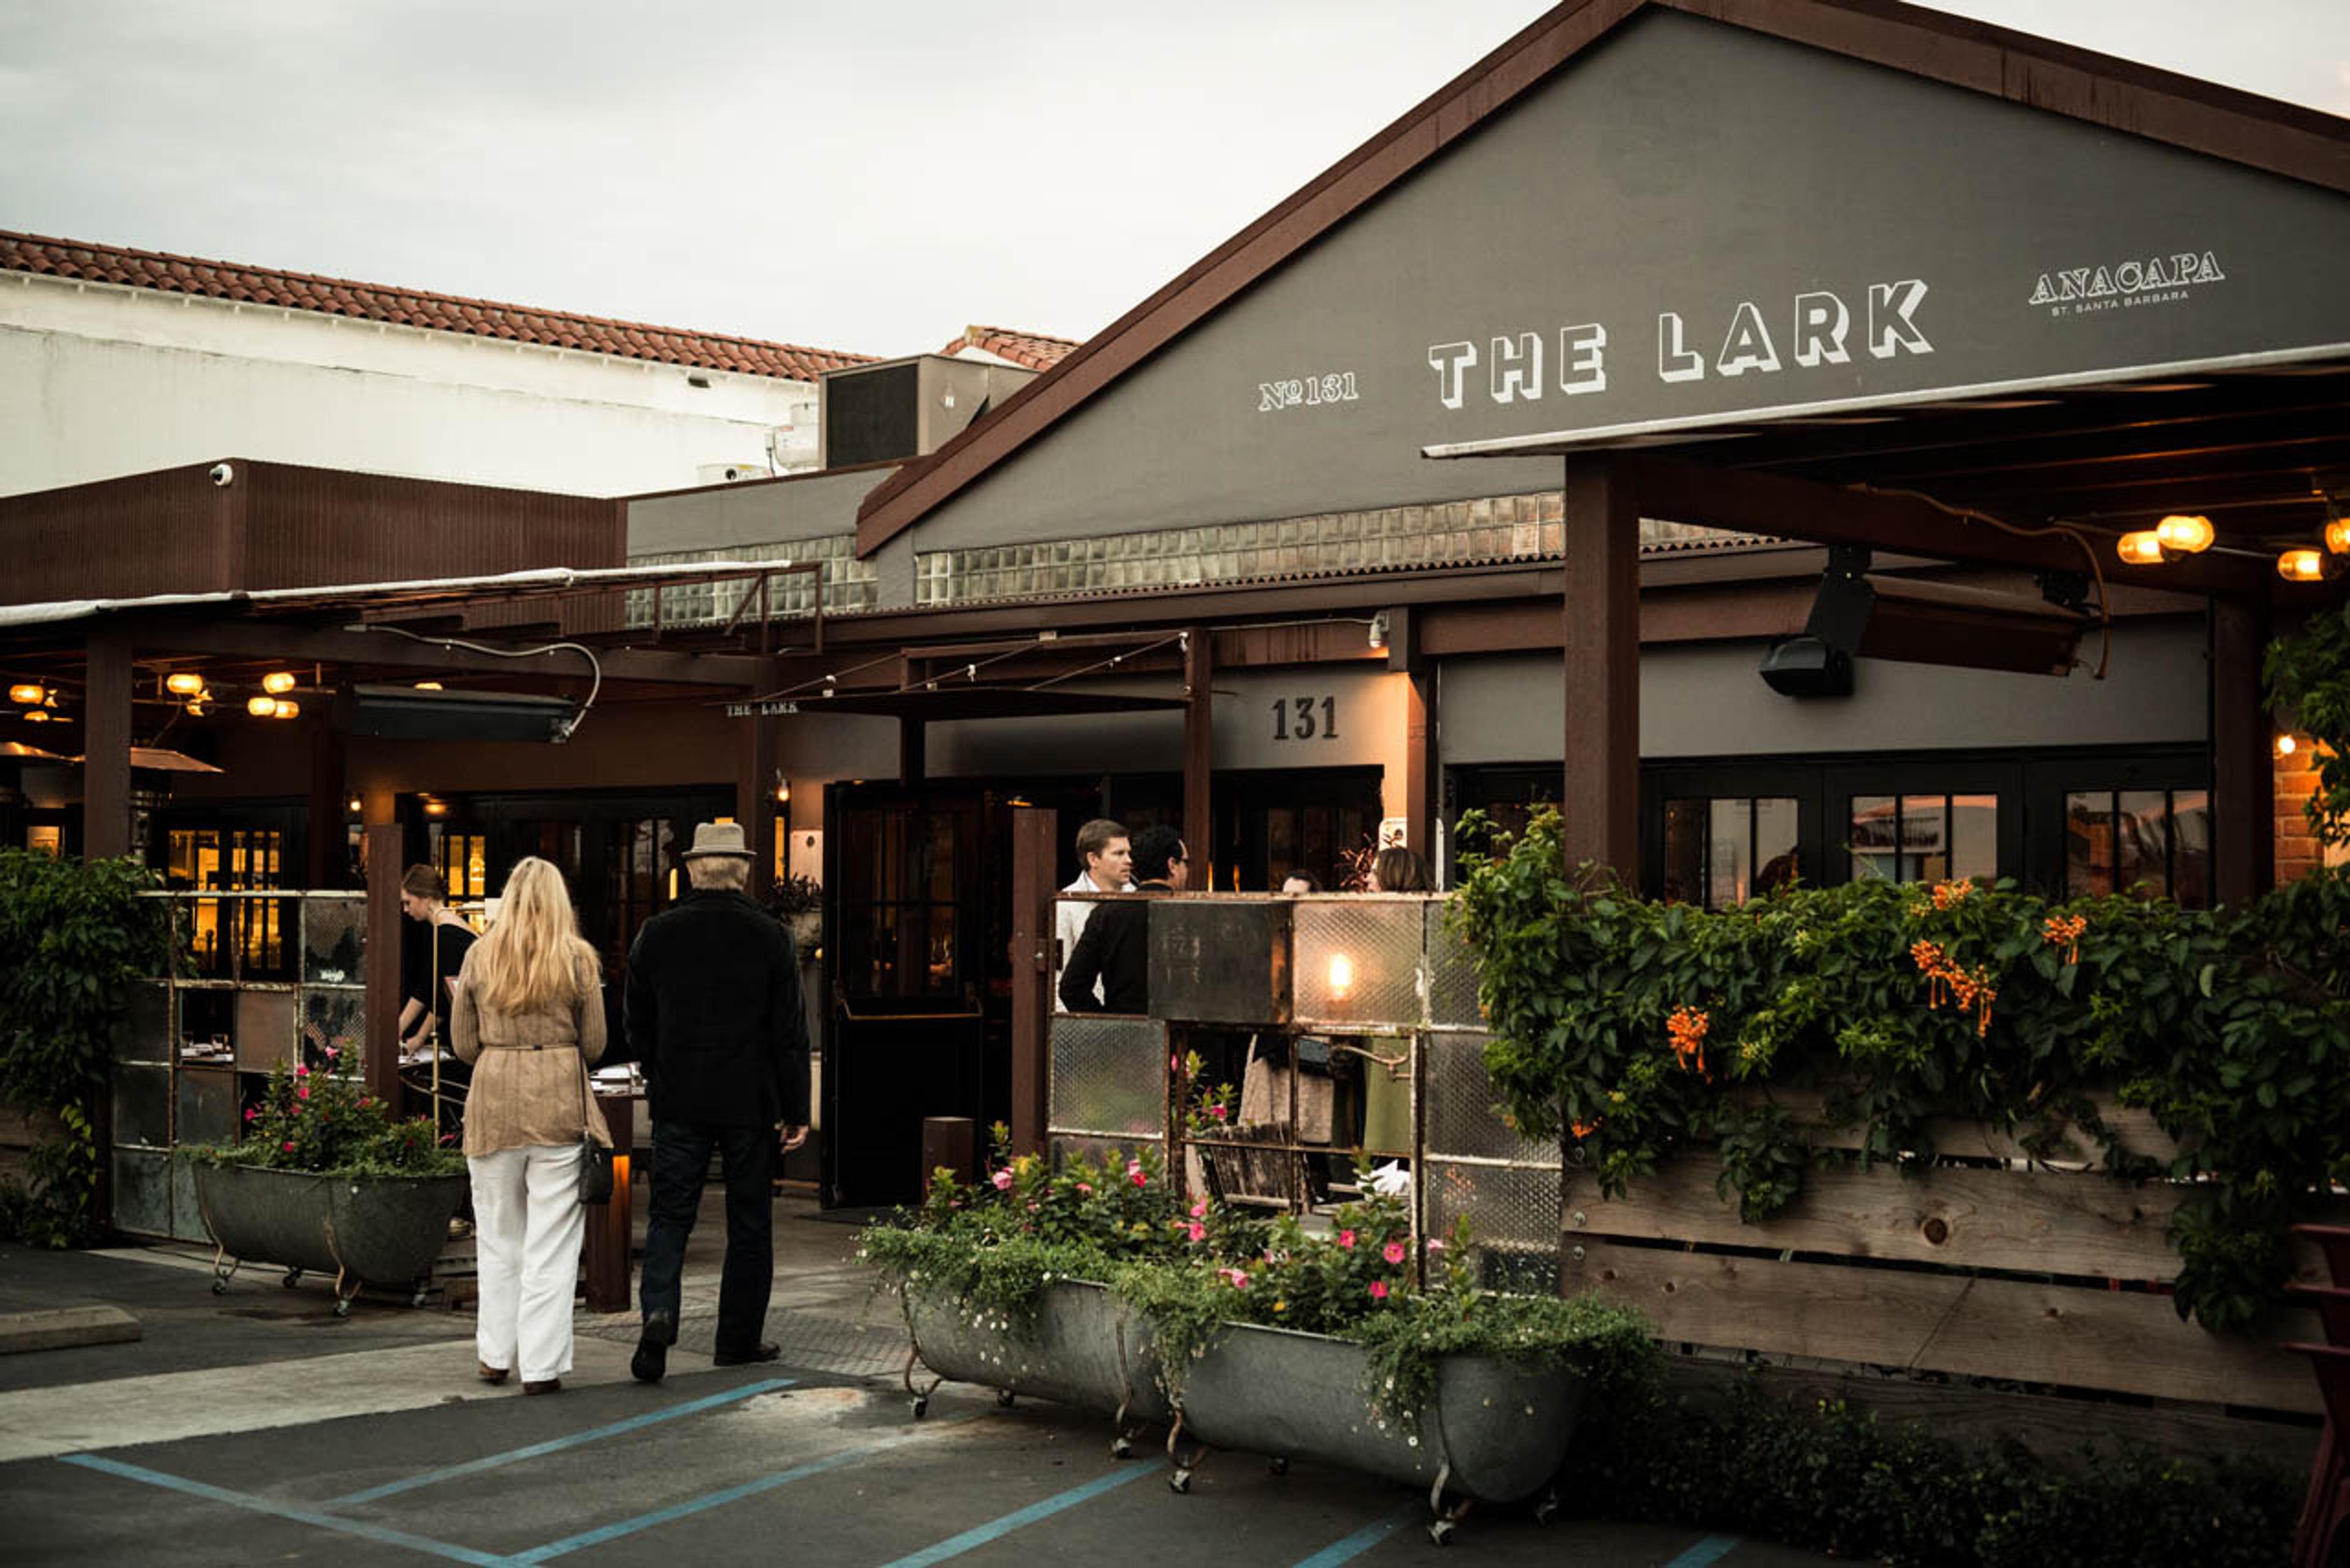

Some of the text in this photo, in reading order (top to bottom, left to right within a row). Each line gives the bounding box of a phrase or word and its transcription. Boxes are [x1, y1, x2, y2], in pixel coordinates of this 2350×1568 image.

[2028, 250, 2226, 305] ANACAPA
[2076, 299, 2119, 313] SANTA
[2124, 290, 2189, 307] BARBARA
[1428, 279, 1935, 410] THE LARK
[726, 704, 751, 718] THE
[1272, 696, 1339, 741] 131
